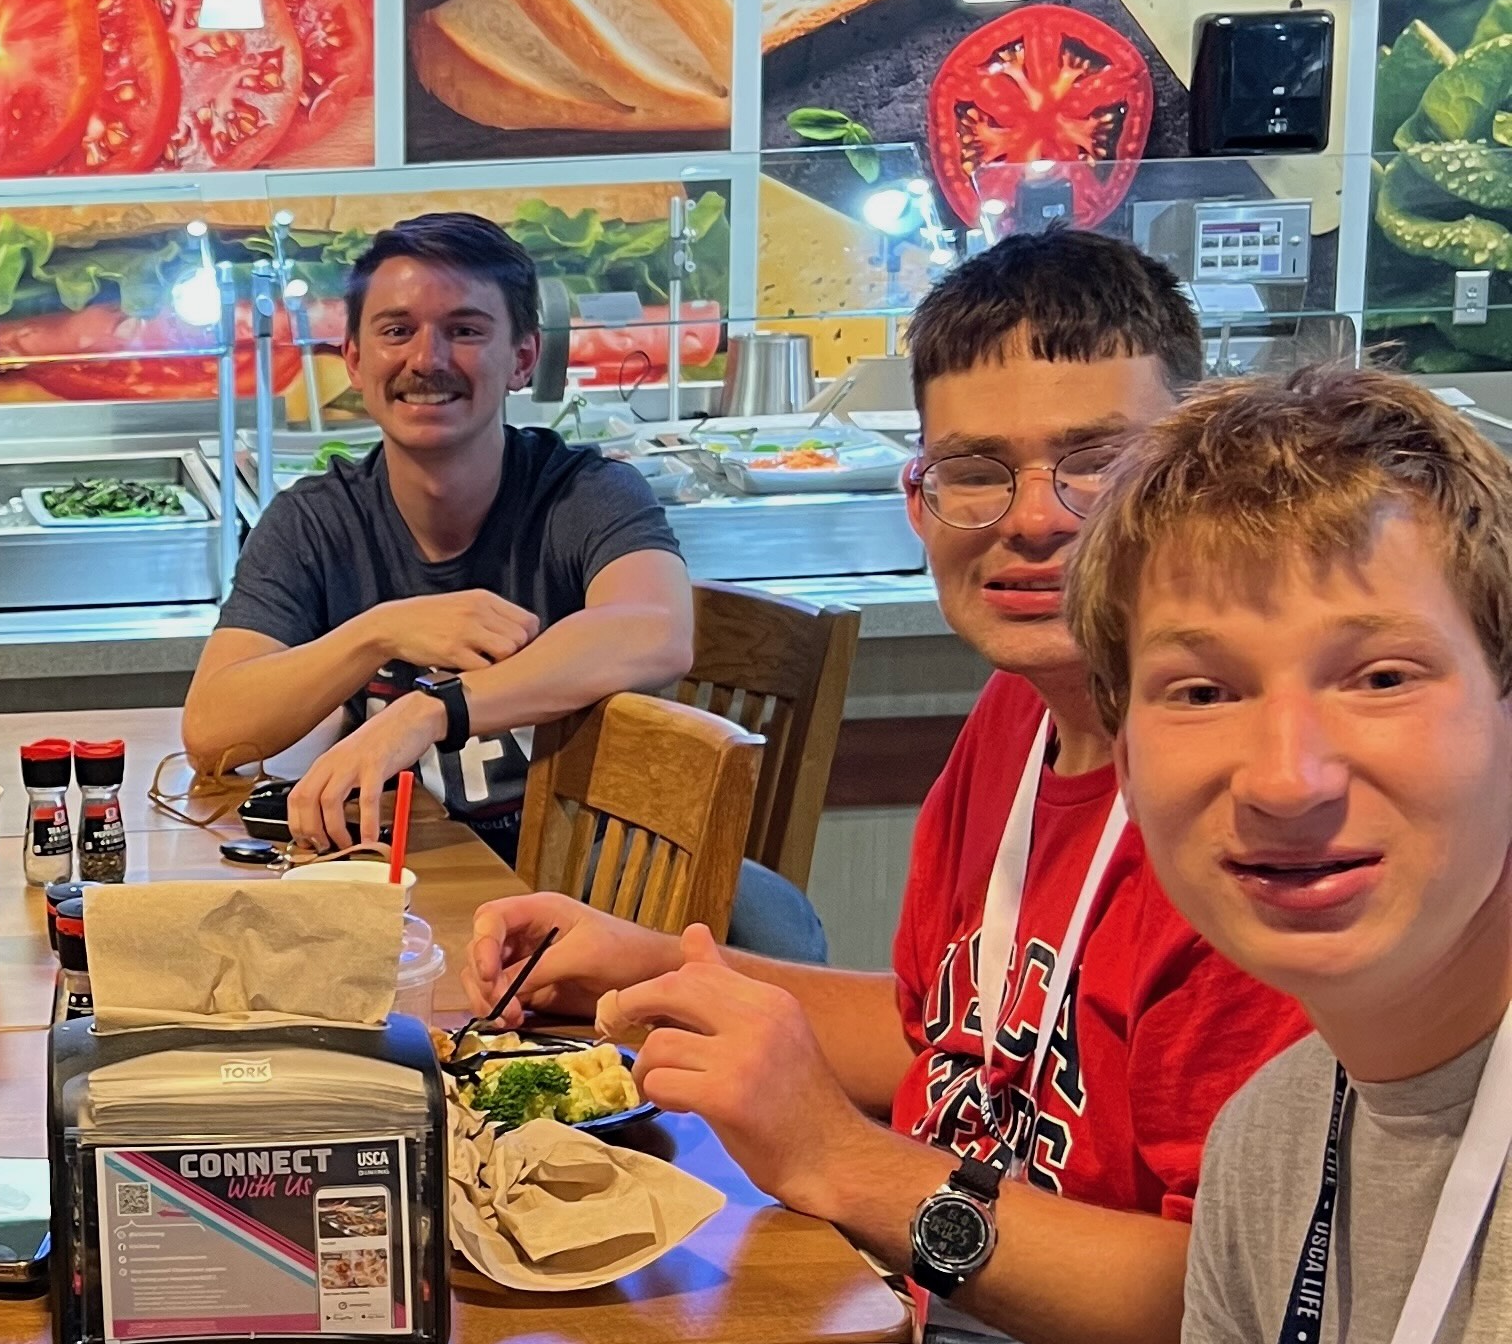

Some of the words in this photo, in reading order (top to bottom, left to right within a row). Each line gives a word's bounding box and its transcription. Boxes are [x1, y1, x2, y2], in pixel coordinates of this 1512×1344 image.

[223, 1065, 269, 1079] TORK
[179, 1148, 333, 1178] CONNECT
[357, 1151, 390, 1167] USCA
[227, 1169, 277, 1199] With
[284, 1174, 313, 1197] Us
[1304, 1221, 1330, 1273] USCA
[1296, 1278, 1323, 1321] LIFE
